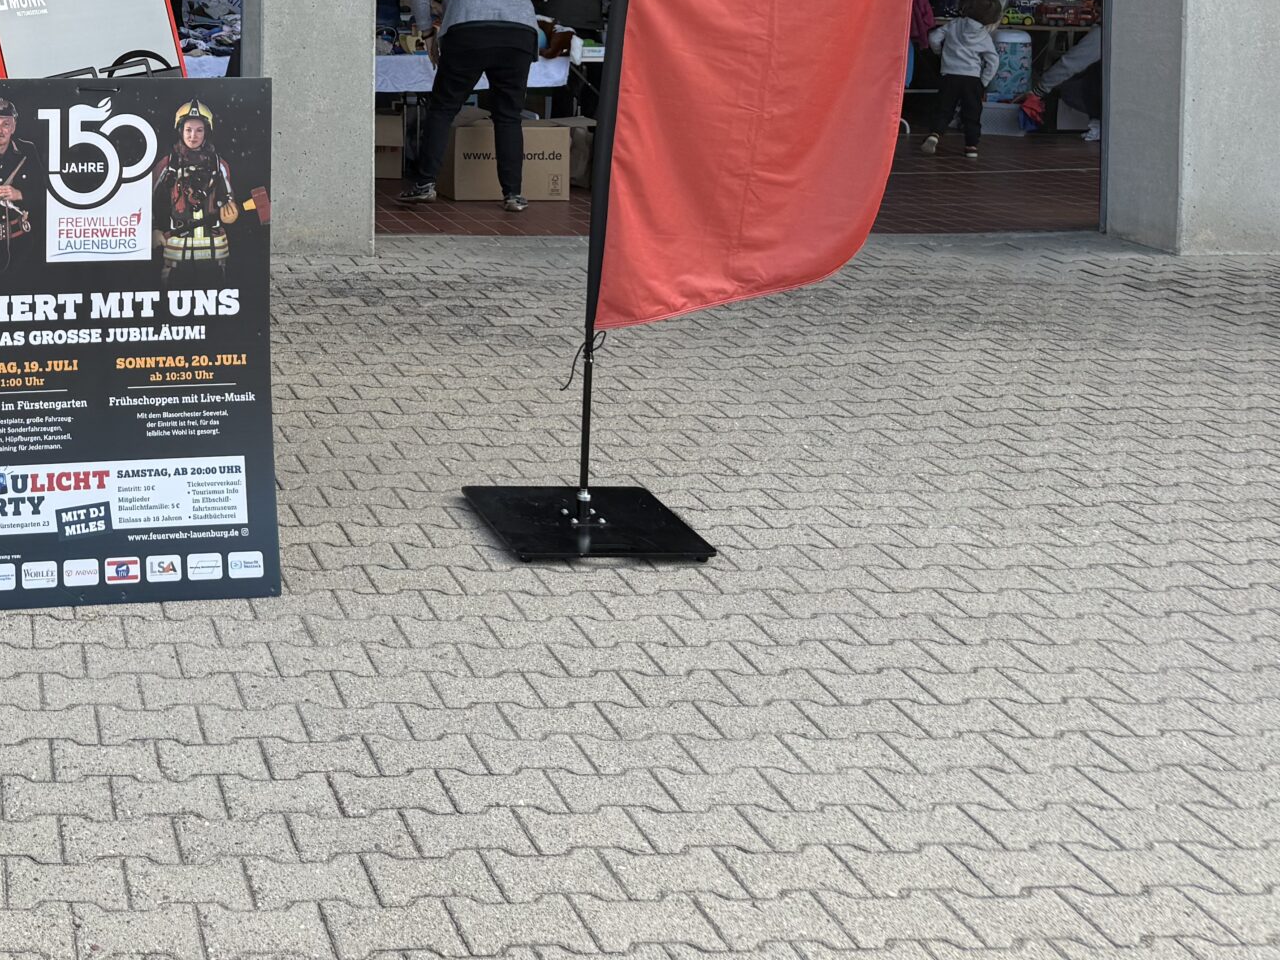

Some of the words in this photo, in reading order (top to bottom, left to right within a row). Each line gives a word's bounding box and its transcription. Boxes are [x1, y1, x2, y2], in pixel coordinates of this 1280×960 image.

[38, 102, 158, 207] 150
[61, 161, 105, 174] JAHRE
[58, 215, 138, 228] FREIWILLIGE
[58, 227, 137, 239] FEUERWEHR
[58, 238, 137, 251] LAUENBURG
[91, 290, 160, 319] MIT
[169, 288, 240, 317] UNS
[29, 328, 102, 345] GROSSE
[105, 325, 206, 343] JUBILÄUM!
[24, 361, 43, 373] 19.
[45, 360, 78, 372] JULI
[116, 355, 189, 369] SONNTAG,
[191, 355, 212, 367] 20.
[214, 354, 247, 366] JULI
[25, 377, 45, 387] Uhr
[150, 372, 162, 381] ab
[165, 371, 192, 381] 10:30
[194, 370, 214, 379] Uhr
[1, 401, 15, 411] im
[17, 399, 88, 412] Fürstengarten
[109, 396, 180, 406] Frühschoppen
[181, 394, 199, 403] mit
[200, 392, 256, 403] Live-Musik
[162, 410, 202, 418] Blasorchester
[157, 420, 178, 428] Eintritt
[172, 428, 187, 436] Wohl
[197, 428, 220, 436] gesorgt.
[117, 468, 171, 479] SAMSTAG,
[173, 468, 188, 476] AB
[190, 467, 217, 475] 20:00
[219, 465, 242, 474] UHR
[118, 496, 150, 504] Mitglieder
[61, 509, 87, 523] MIT
[89, 506, 105, 518] DJ
[64, 520, 106, 537] MILES
[128, 528, 239, 541] www.feuerwehr-lauenburg.de
[150, 560, 177, 574] LSA
